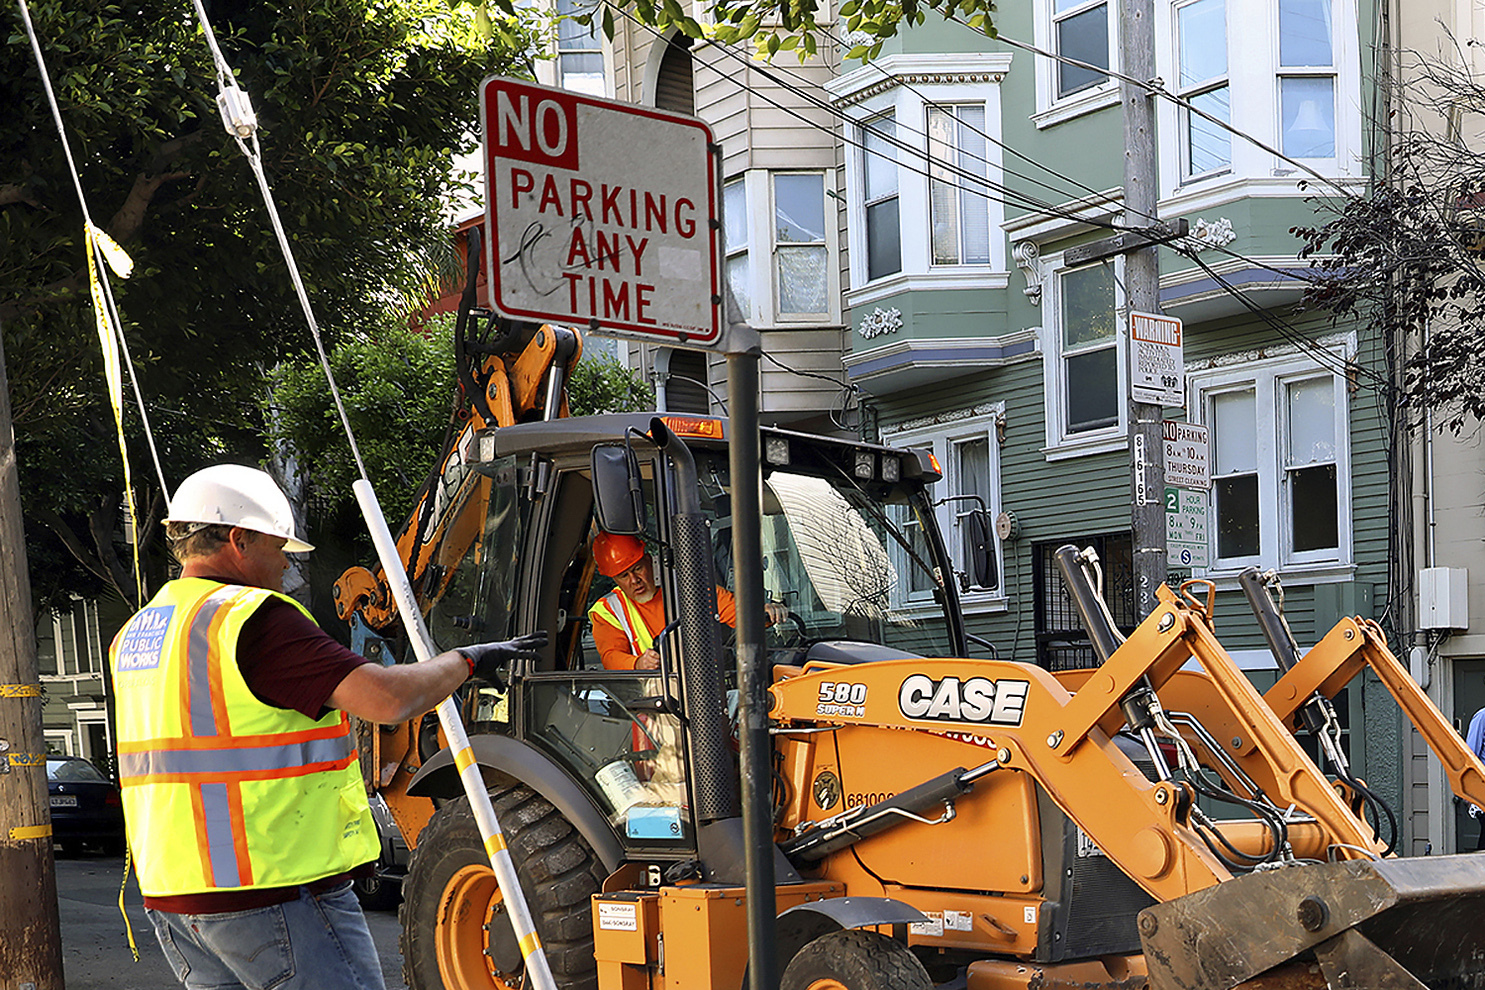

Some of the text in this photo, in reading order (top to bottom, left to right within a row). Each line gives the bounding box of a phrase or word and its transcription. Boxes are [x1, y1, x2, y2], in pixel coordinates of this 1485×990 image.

[497, 90, 568, 157] NO
[511, 167, 696, 239] PARKING
[567, 226, 648, 276] ANY
[562, 272, 657, 325] TIME
[1134, 316, 1178, 345] WARNING
[1162, 422, 1208, 444] NO PARKING
[1136, 436, 1145, 505] 816165
[1167, 461, 1205, 476] THURSDAY
[1167, 475, 1208, 487] STREET CLEANING
[1167, 493, 1201, 510] 2 HOUR
[1182, 505, 1205, 515] PARKING
[1168, 531, 1182, 540] MON
[1196, 533, 1205, 541] FRI
[1140, 575, 1148, 604] 23
[122, 636, 162, 652] PUBLIC
[121, 651, 159, 668] WORKS
[818, 682, 867, 704] 580
[900, 674, 1029, 725] CASE
[817, 704, 855, 717] SUPER
